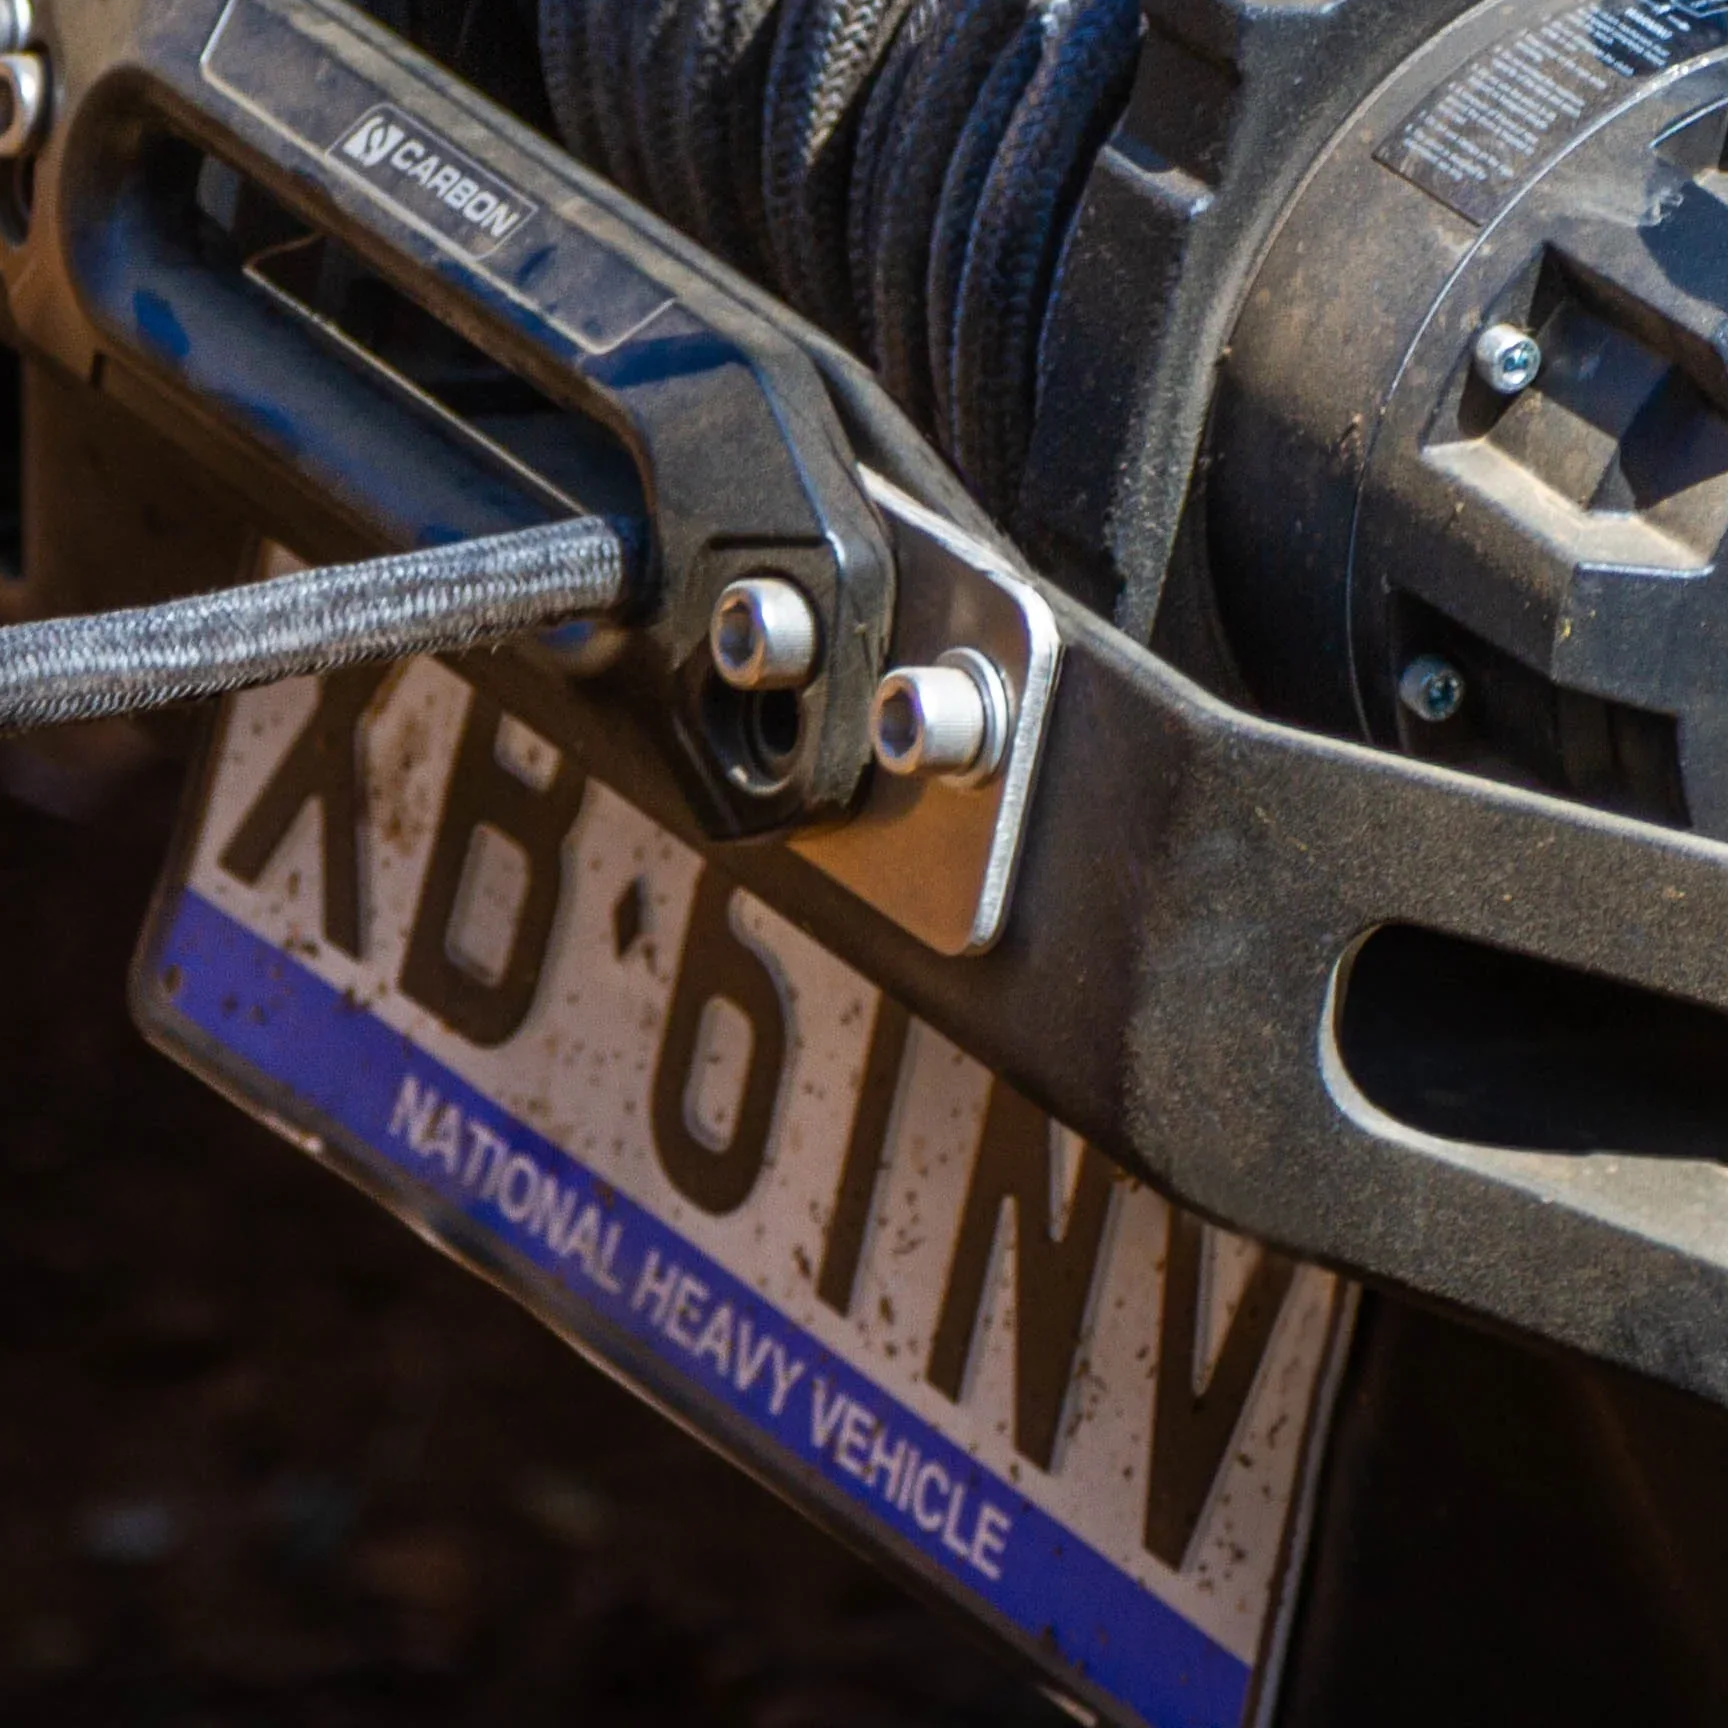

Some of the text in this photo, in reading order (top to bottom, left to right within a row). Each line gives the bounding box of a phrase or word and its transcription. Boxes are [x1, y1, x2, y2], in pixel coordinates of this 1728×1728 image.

[391, 138, 521, 237] CARBON
[386, 1075, 1011, 1581] NATIONAL HEAVY VEHICLE
